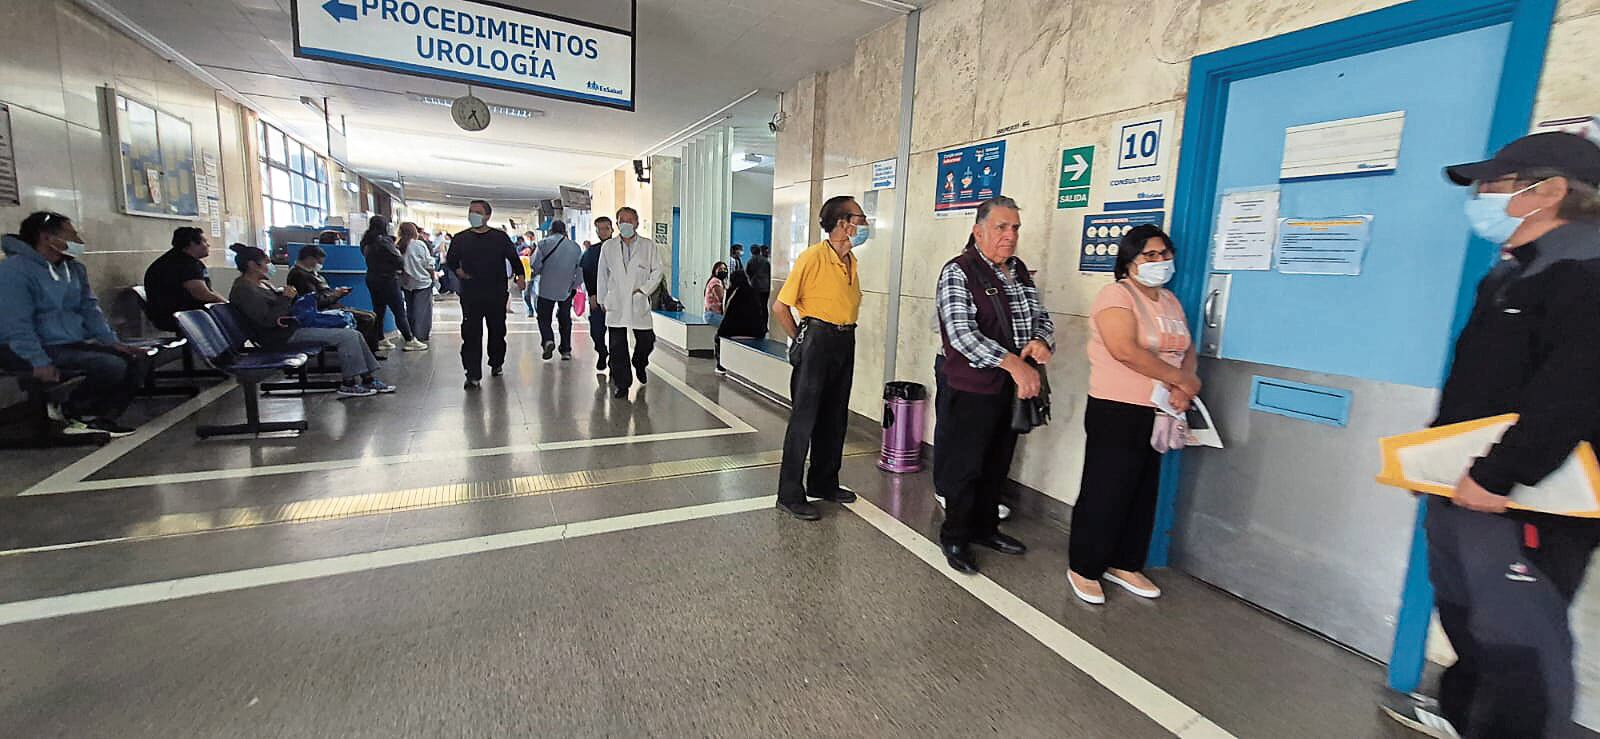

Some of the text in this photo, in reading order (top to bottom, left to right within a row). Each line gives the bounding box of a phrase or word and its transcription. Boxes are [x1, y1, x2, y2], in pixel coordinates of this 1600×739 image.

[362, 0, 598, 59] PROCEDIMIENTOS
[416, 35, 556, 80] UROLOGÍA
[1124, 131, 1157, 160] 10
[1110, 175, 1160, 186] CONSULTORIO
[1060, 194, 1087, 203] SALIDA
